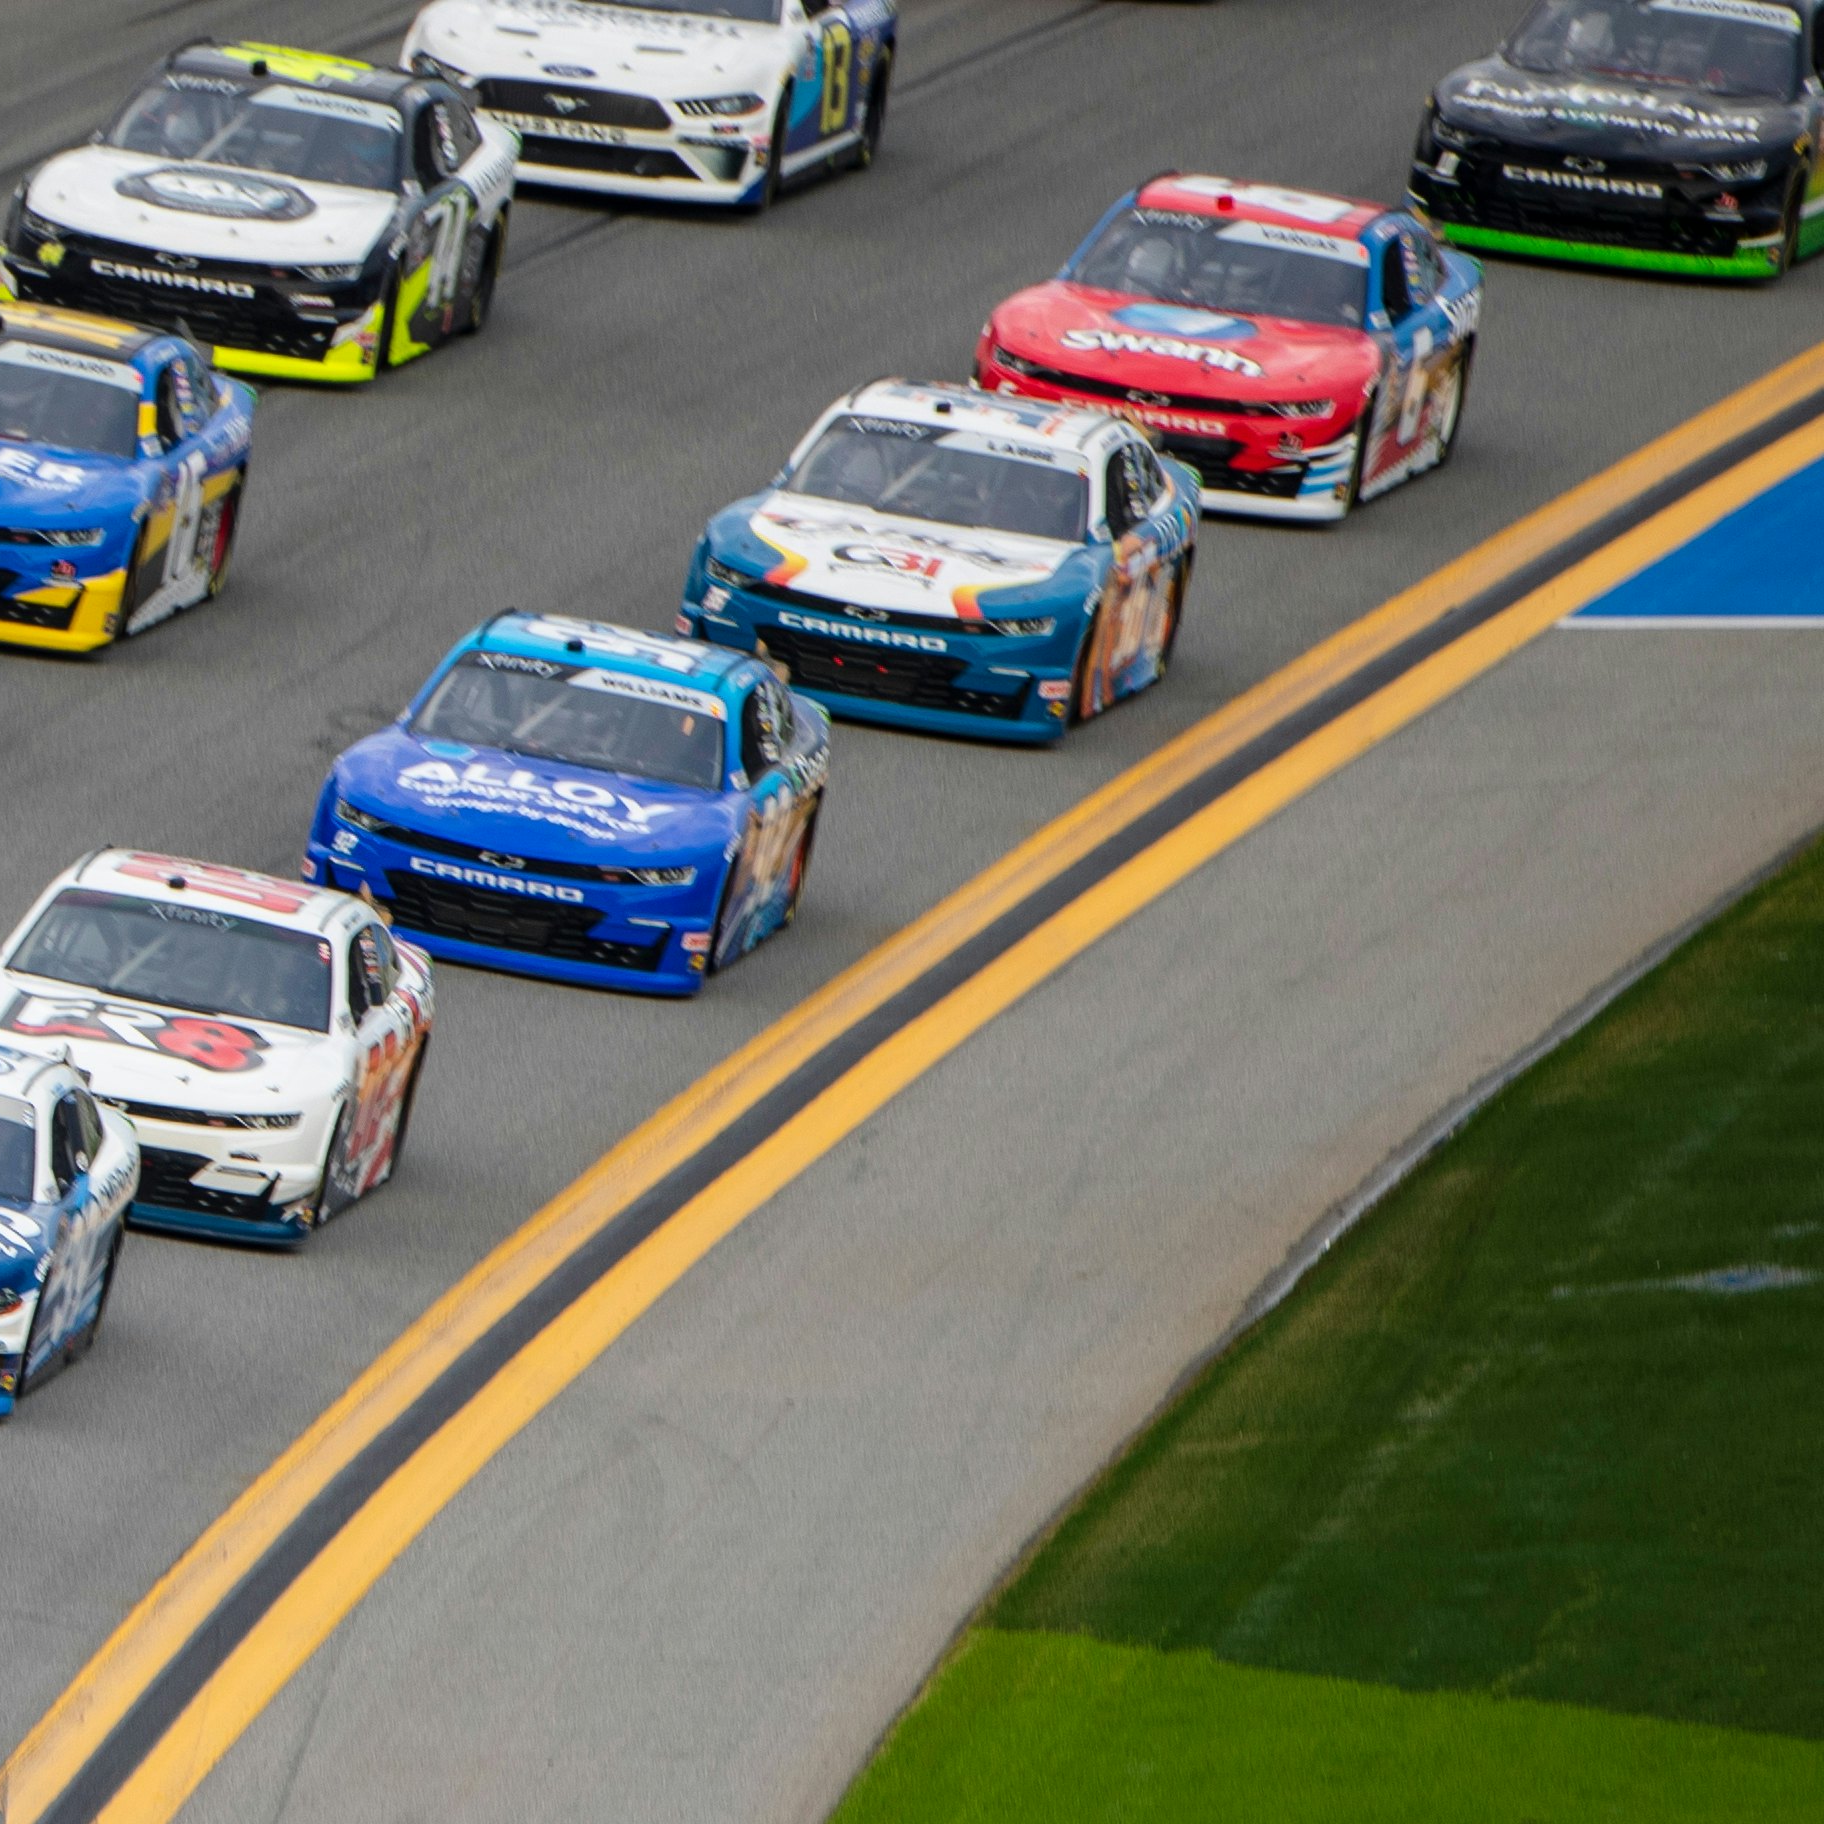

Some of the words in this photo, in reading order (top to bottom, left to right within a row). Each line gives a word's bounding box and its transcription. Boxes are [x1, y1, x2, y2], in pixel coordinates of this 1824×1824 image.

[90, 258, 255, 299] CAMARO
[779, 611, 948, 652] CAMARO
[398, 760, 676, 824] ALLOY
[409, 856, 585, 904] CAMARO
